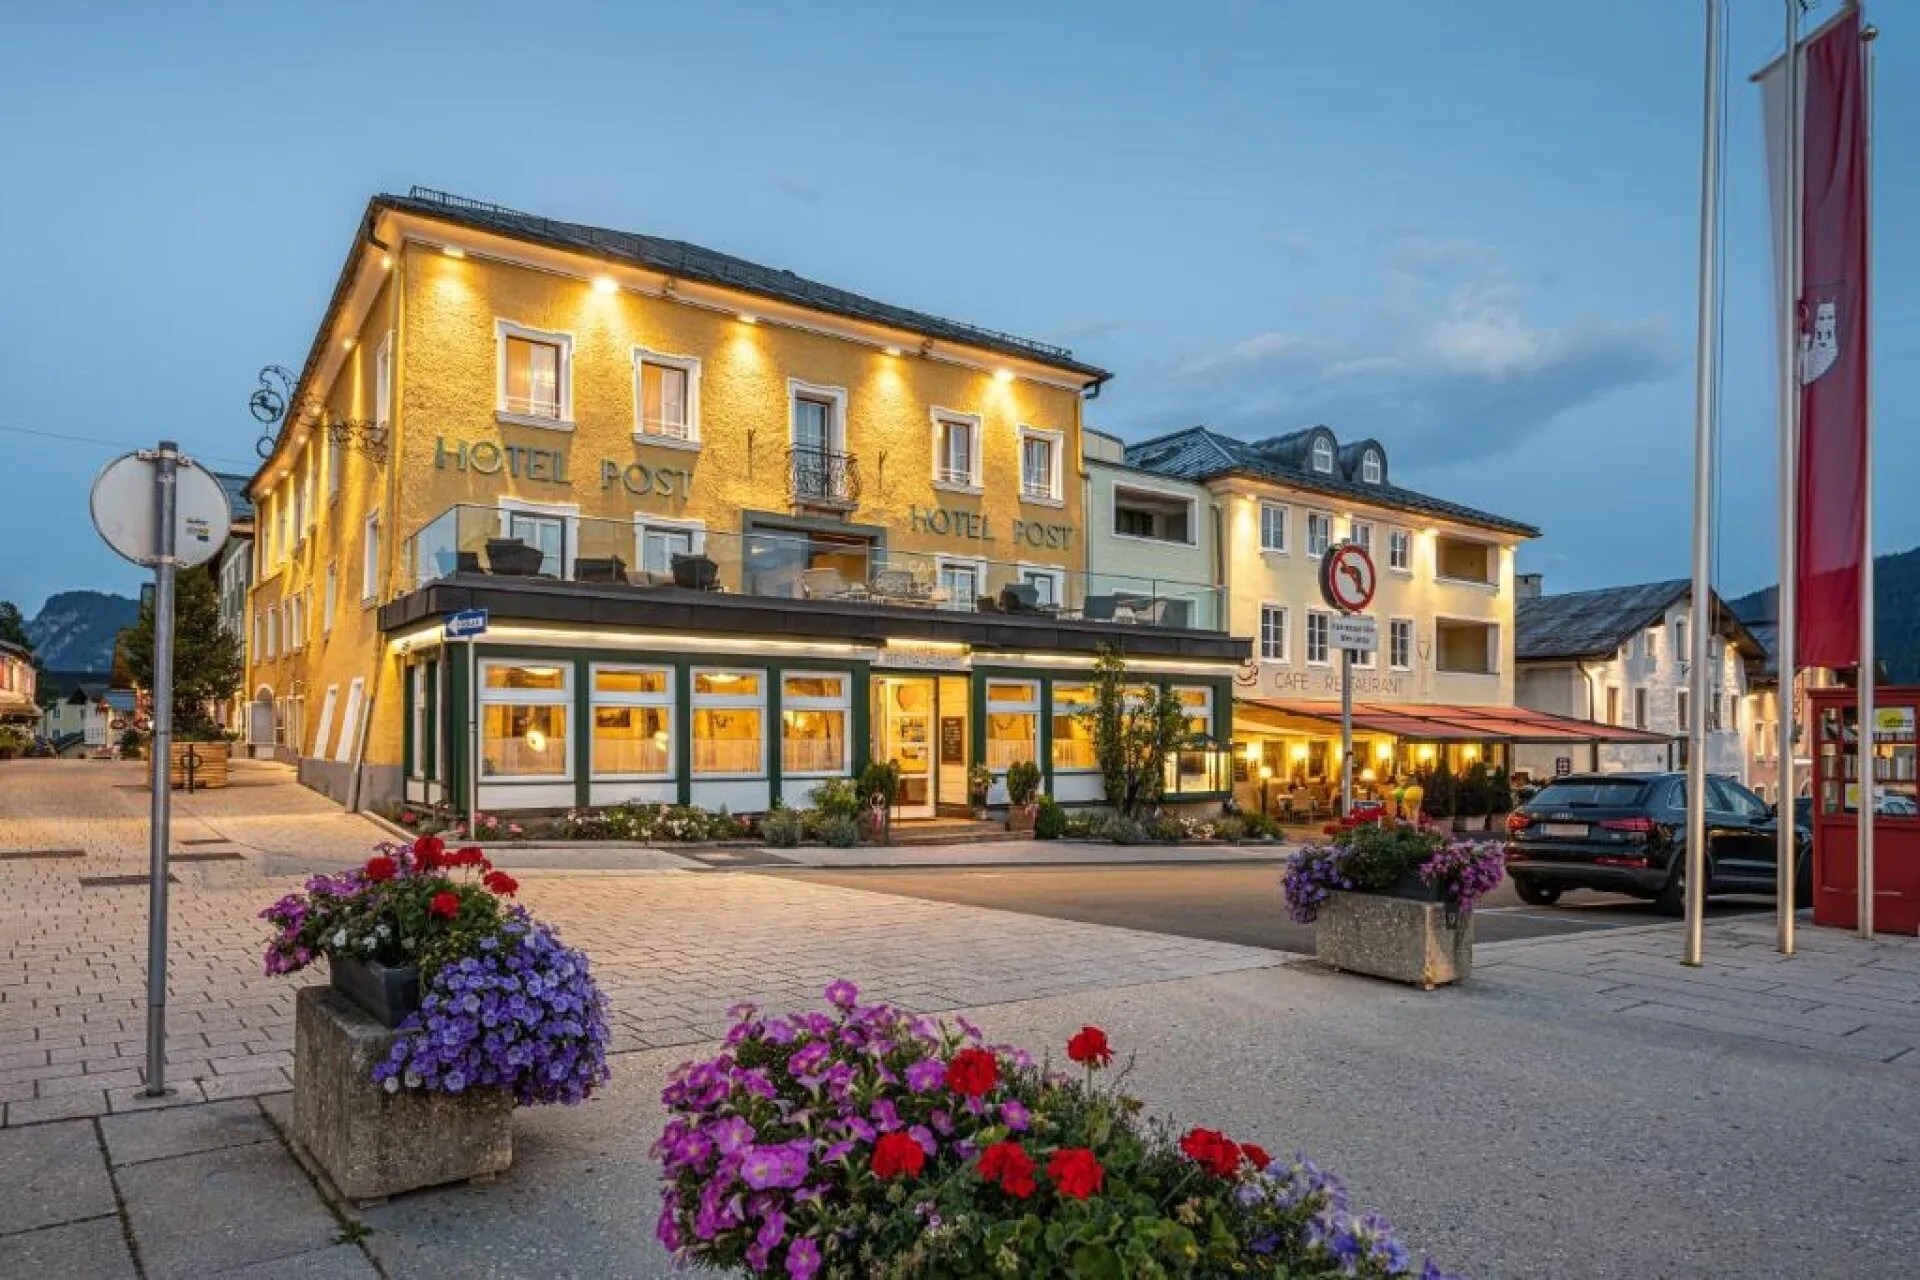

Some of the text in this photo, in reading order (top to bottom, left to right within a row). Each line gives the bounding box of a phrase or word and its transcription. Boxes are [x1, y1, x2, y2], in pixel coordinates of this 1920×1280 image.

[435, 436, 694, 500] HOTEL POST
[910, 504, 1074, 551] HOTEL POST
[1275, 672, 1404, 694] CAFE RETAURANT
